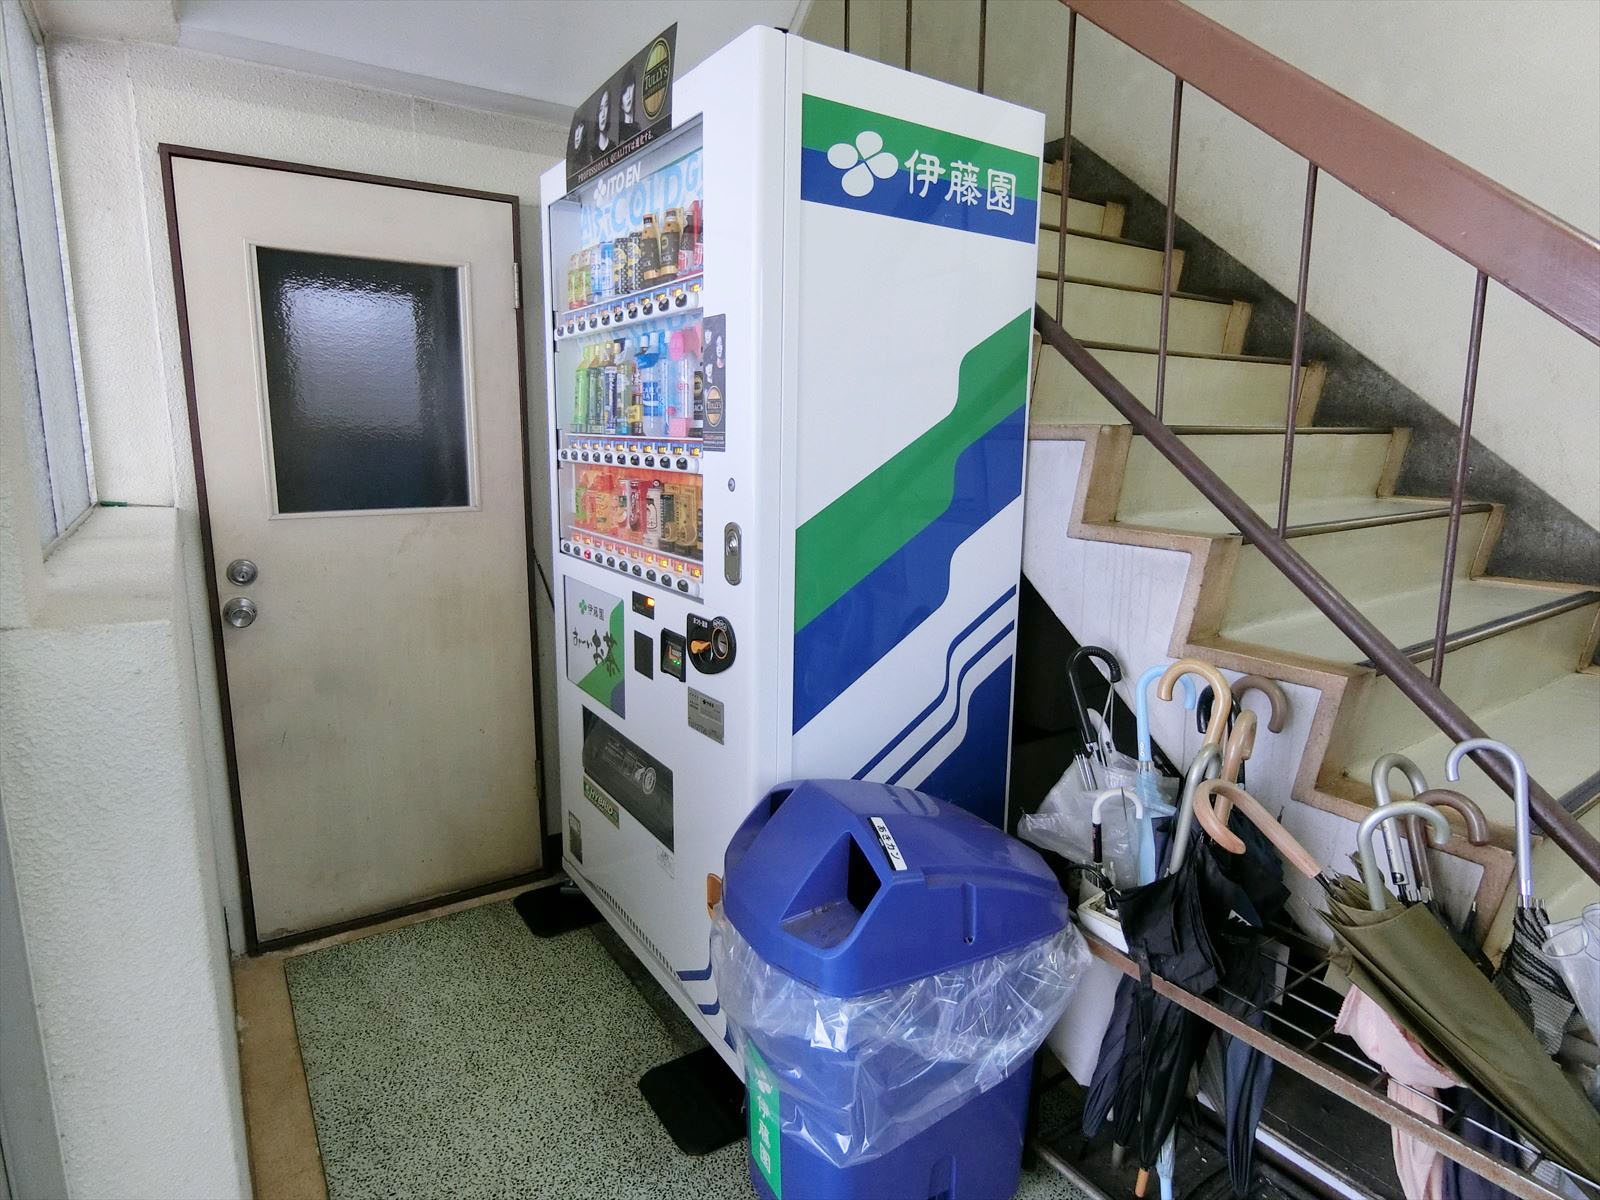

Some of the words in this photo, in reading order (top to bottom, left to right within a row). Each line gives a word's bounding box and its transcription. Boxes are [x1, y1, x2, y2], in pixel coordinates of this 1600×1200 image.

[607, 170, 625, 198] ITO
[625, 161, 641, 189] EN
[904, 149, 1016, 215] 伊藤園
[588, 788, 613, 816] HYBRID
[877, 824, 901, 860] あきカン
